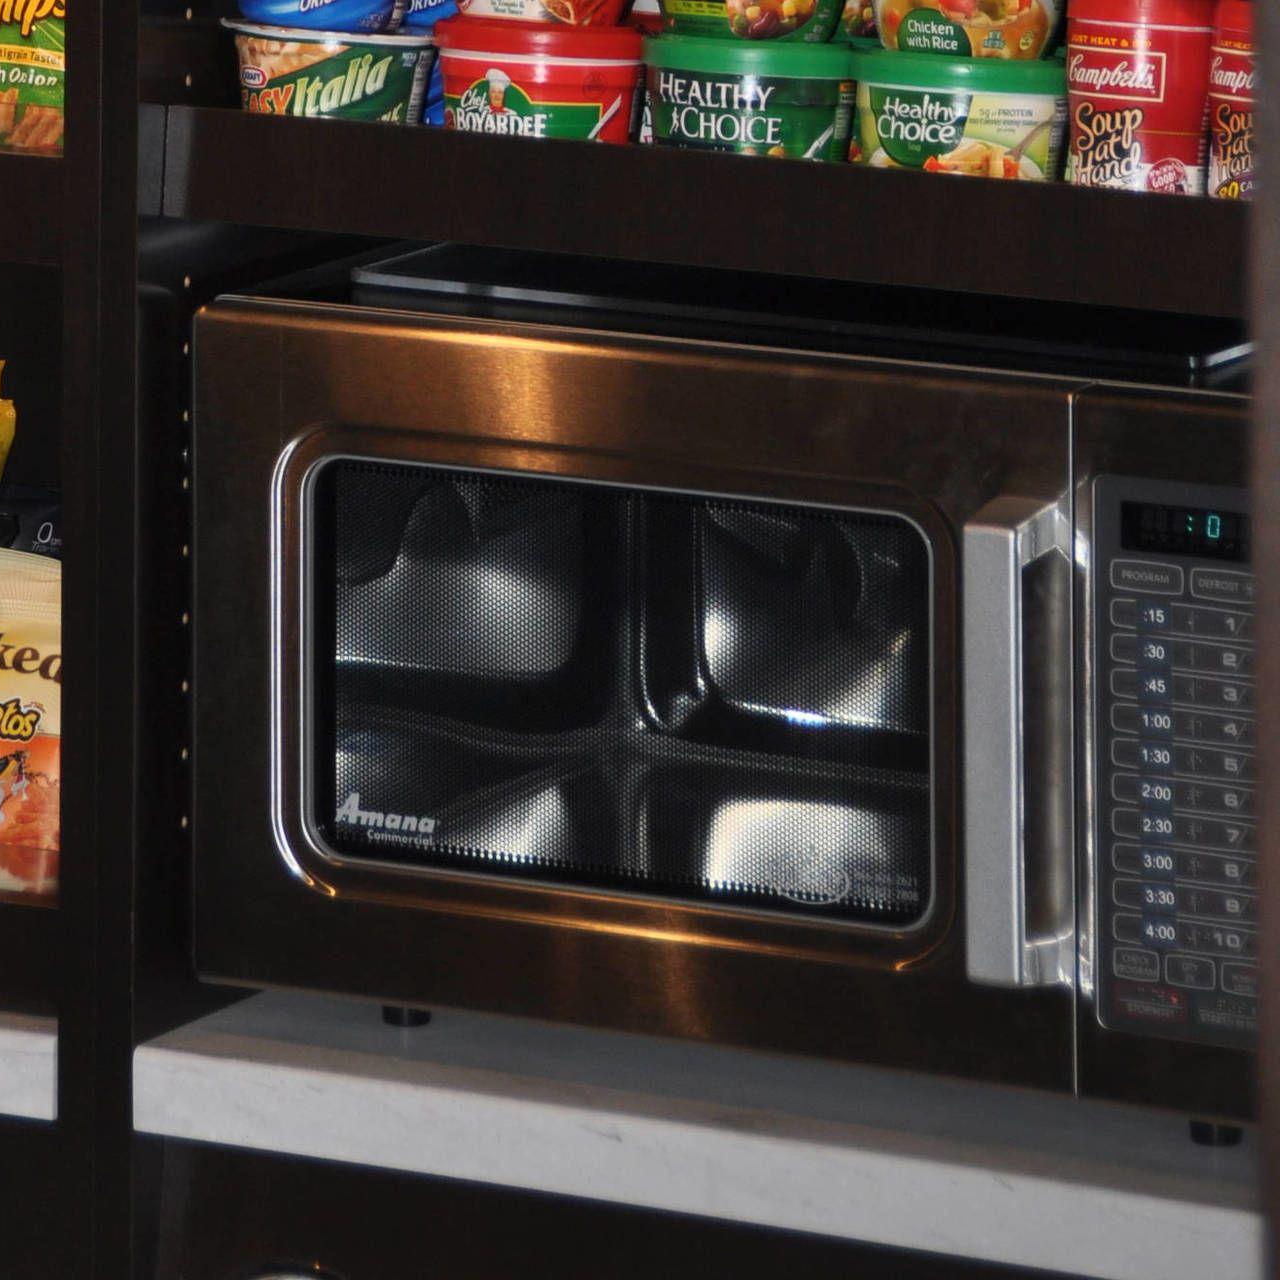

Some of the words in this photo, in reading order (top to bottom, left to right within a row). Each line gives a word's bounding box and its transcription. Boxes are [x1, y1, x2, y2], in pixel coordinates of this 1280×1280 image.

[907, 19, 954, 37] Chicken
[907, 36, 930, 50] with
[932, 36, 958, 50] Rice
[1090, 35, 1118, 45] HEAT
[9, 68, 58, 87] Onion
[1070, 54, 1156, 90] Campbell's
[293, 54, 393, 117] Italia
[659, 72, 775, 112] HEALTHY
[460, 89, 488, 111] Chef
[883, 95, 961, 126] Healthy
[680, 107, 783, 144] CHOICE
[877, 114, 956, 143] Choice
[1075, 102, 1143, 150] Soup
[1095, 135, 1121, 160] at
[1076, 141, 1142, 187] Hand
[1122, 568, 1170, 584] PROGRAM
[1198, 577, 1239, 592] DEFROST
[1142, 714, 1171, 729] 1:00
[1141, 748, 1171, 764] 1:30
[1142, 784, 1171, 801] 2:00
[335, 792, 435, 833] Amana
[1143, 819, 1173, 834] 2:30
[367, 829, 433, 846] Commercial
[1143, 854, 1173, 870] 3:00
[1145, 889, 1175, 905] 3:30
[1145, 923, 1176, 941] 4:00
